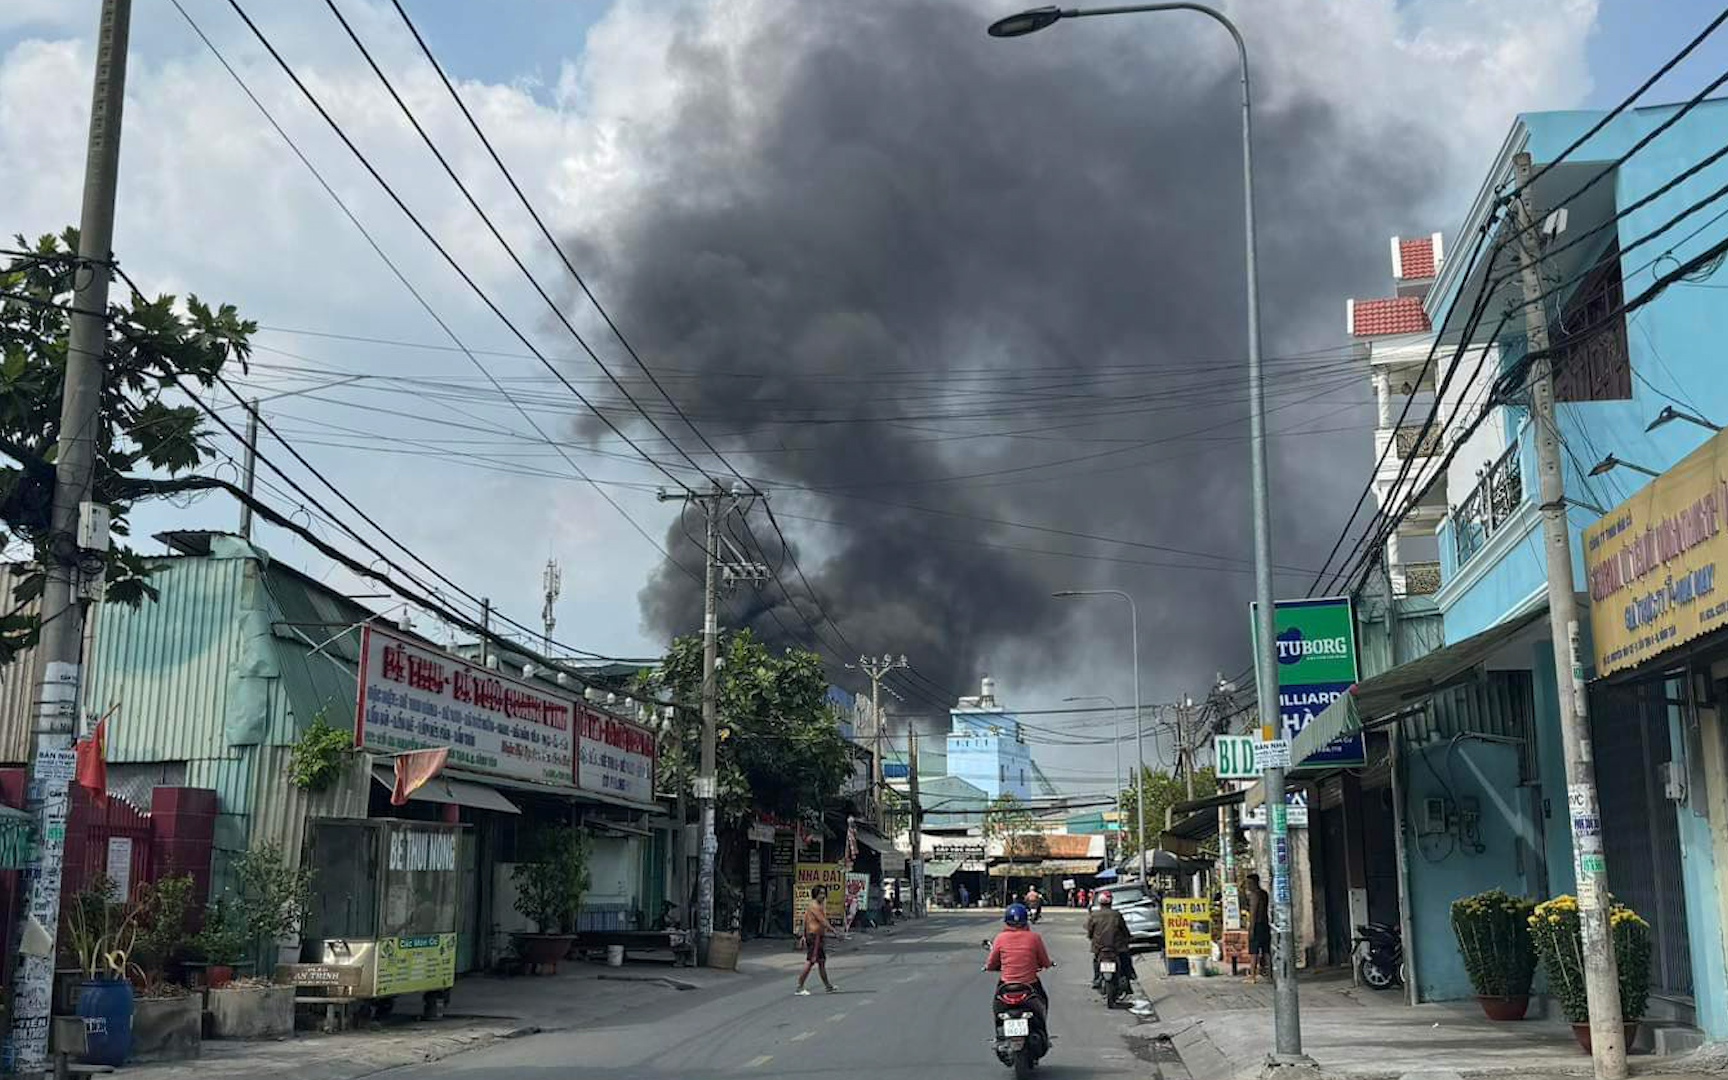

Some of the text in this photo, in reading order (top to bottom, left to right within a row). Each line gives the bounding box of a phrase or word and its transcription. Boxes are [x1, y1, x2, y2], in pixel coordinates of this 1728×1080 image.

[1276, 637, 1347, 658] TUBORG
[1279, 691, 1341, 706] ILLIARD
[1282, 708, 1314, 731] HÀ
[1218, 739, 1259, 774] BID
[1172, 930, 1186, 938] XE
